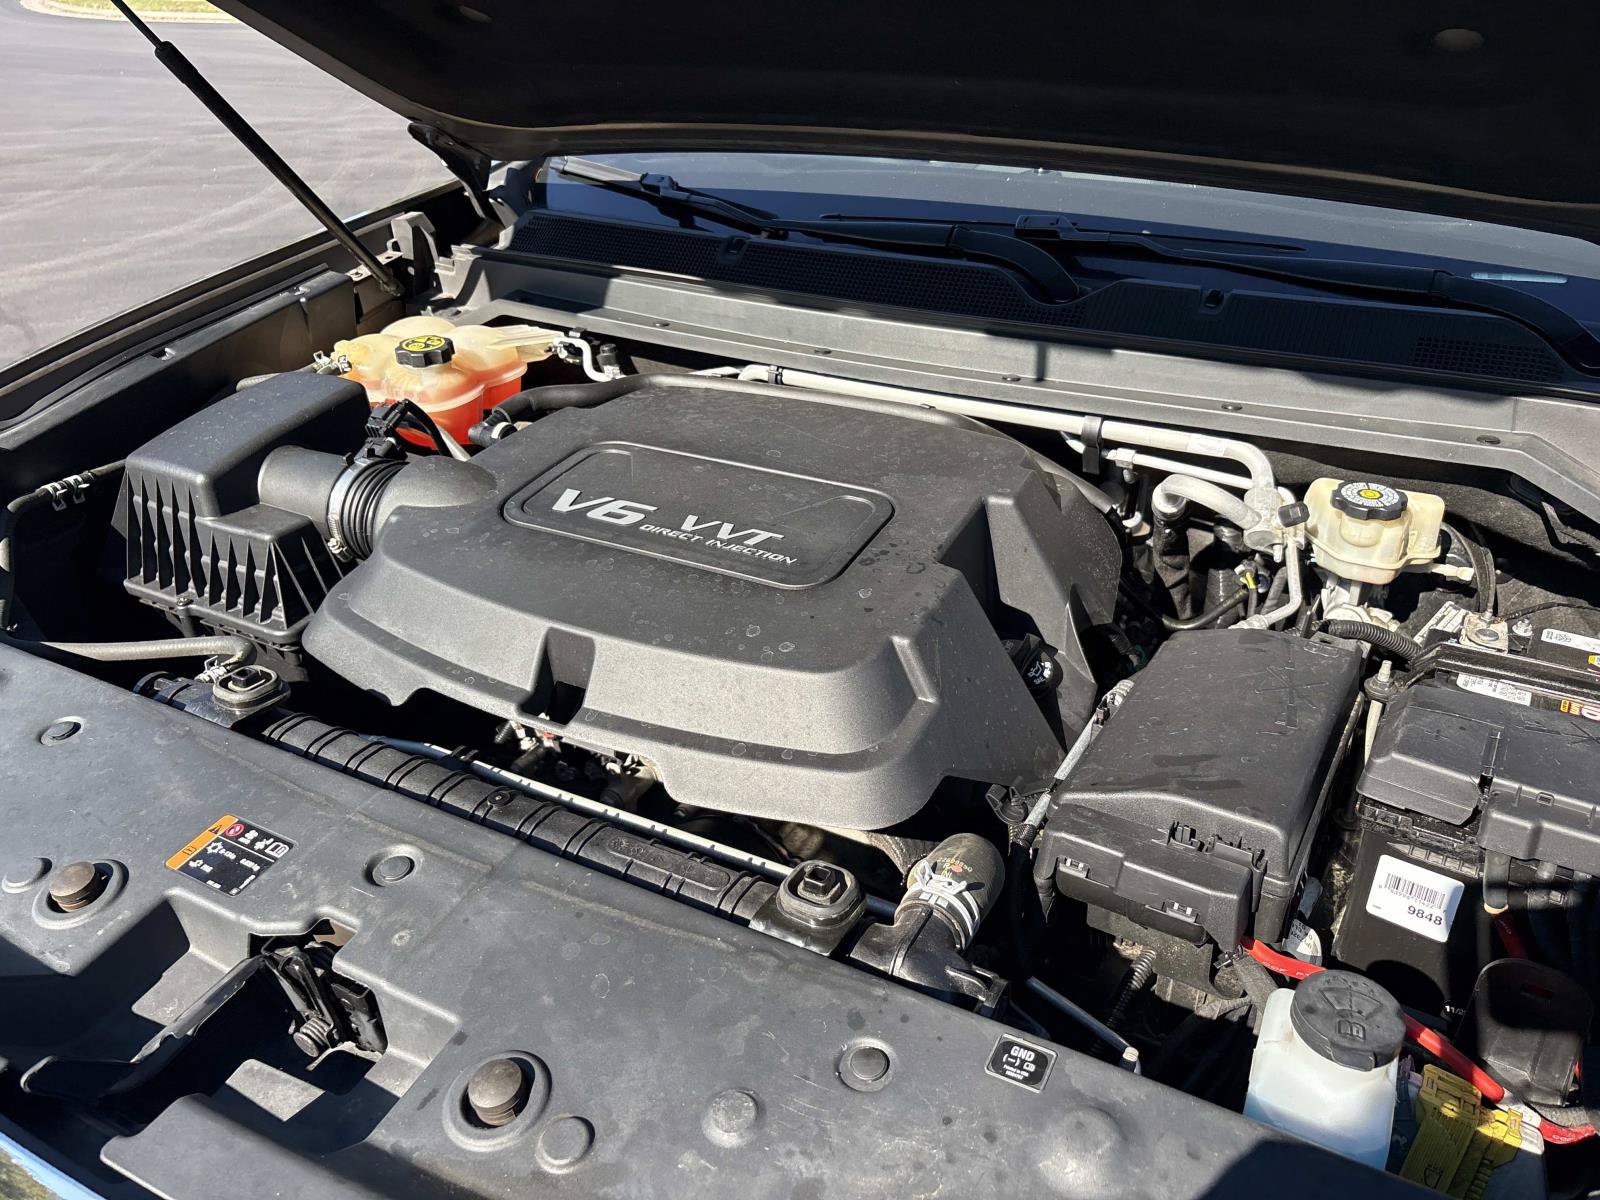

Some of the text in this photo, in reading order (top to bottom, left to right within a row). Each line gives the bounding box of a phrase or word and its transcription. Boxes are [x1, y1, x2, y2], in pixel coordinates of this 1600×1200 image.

[551, 488, 785, 547] V6 VVT
[639, 523, 797, 565] DIRECT INJECTION
[1407, 905, 1443, 926] 9848
[1011, 1046, 1035, 1061] GND
